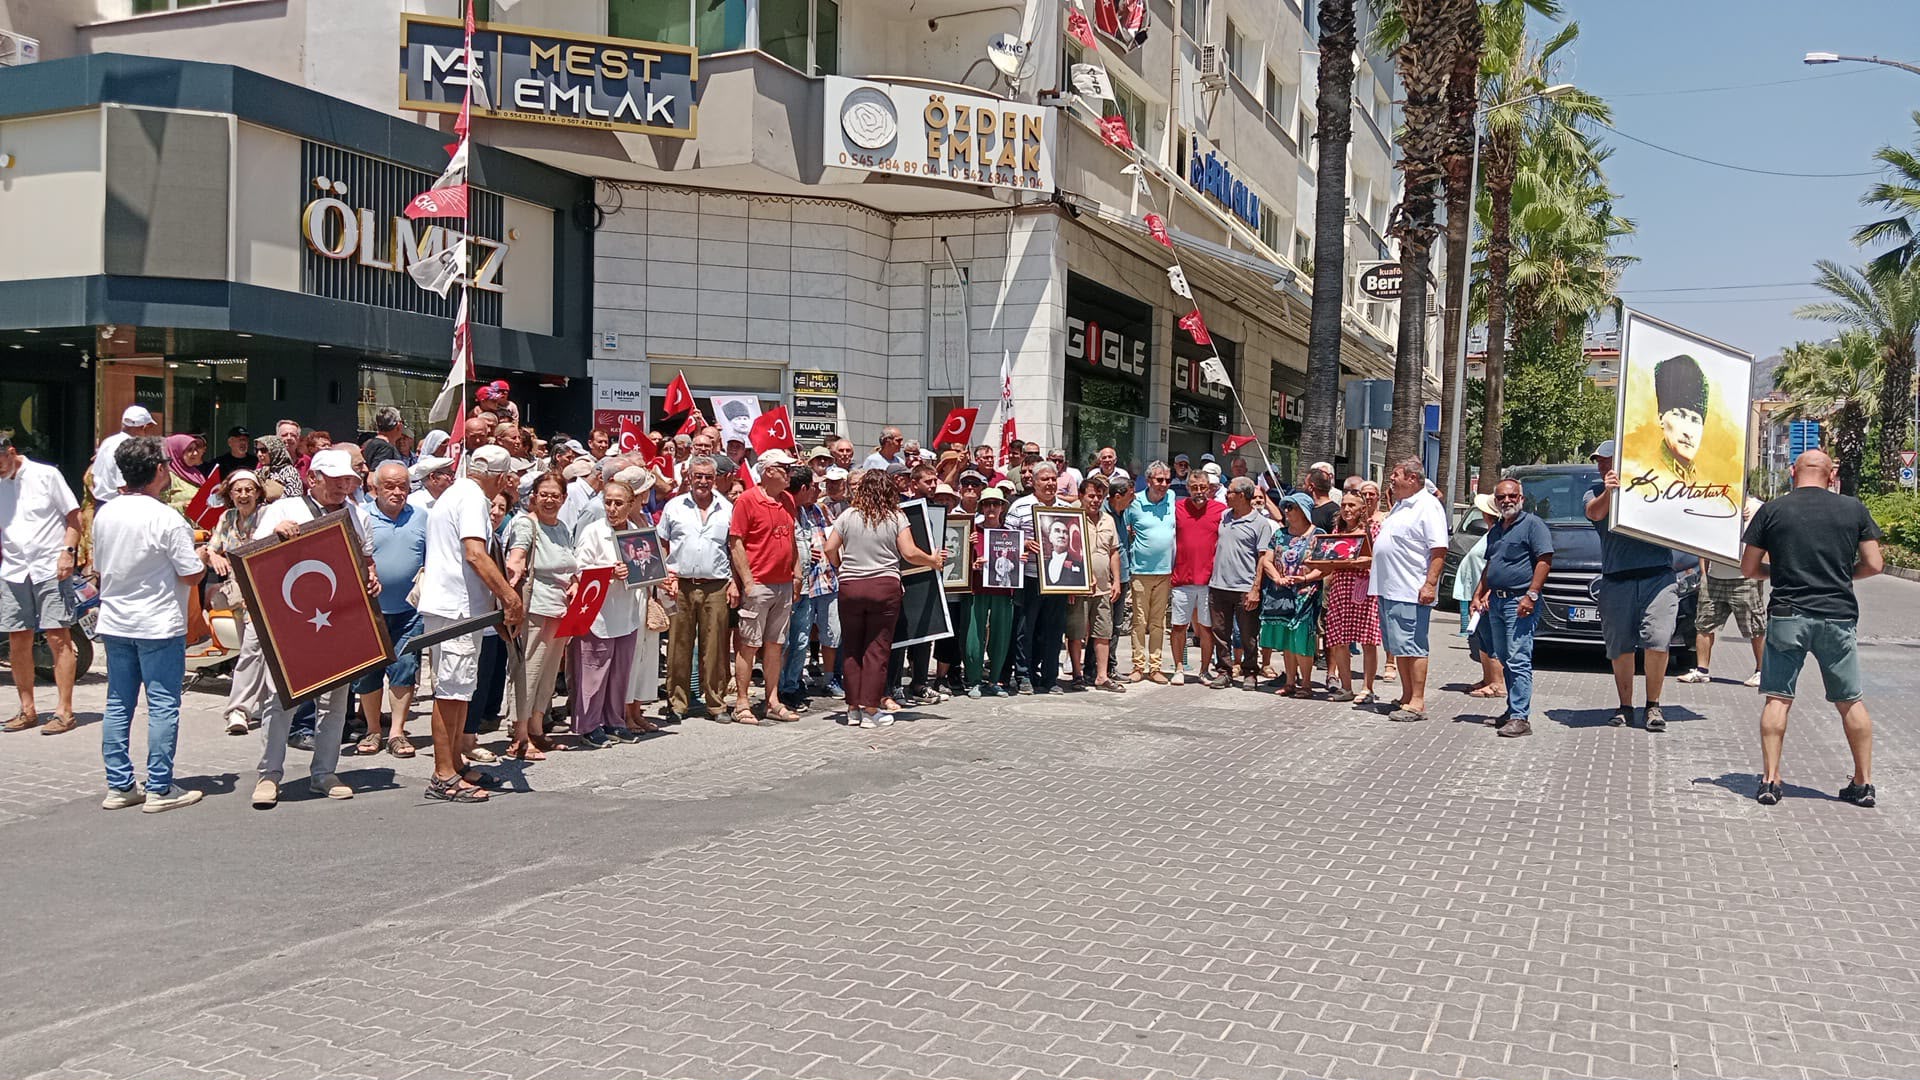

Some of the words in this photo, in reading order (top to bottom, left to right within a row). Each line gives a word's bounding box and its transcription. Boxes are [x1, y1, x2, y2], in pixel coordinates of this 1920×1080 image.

[530, 40, 661, 82] MEST
[514, 78, 676, 124] EMLAK
[923, 94, 1042, 142] ÖZDEN
[838, 152, 847, 164] 0
[851, 153, 874, 167] 545
[878, 157, 900, 171] 684
[904, 160, 918, 174] 89
[922, 164, 938, 176] 04
[952, 167, 958, 179] 0
[963, 168, 984, 182] 542
[988, 172, 1008, 184] 684
[1012, 174, 1025, 186] 89
[927, 131, 1041, 172] EMLAK
[414, 194, 438, 213] CHP
[1379, 267, 1402, 276] kuafö
[1065, 316, 1145, 376] GIGLE
[800, 422, 831, 431] KUAFÖR
